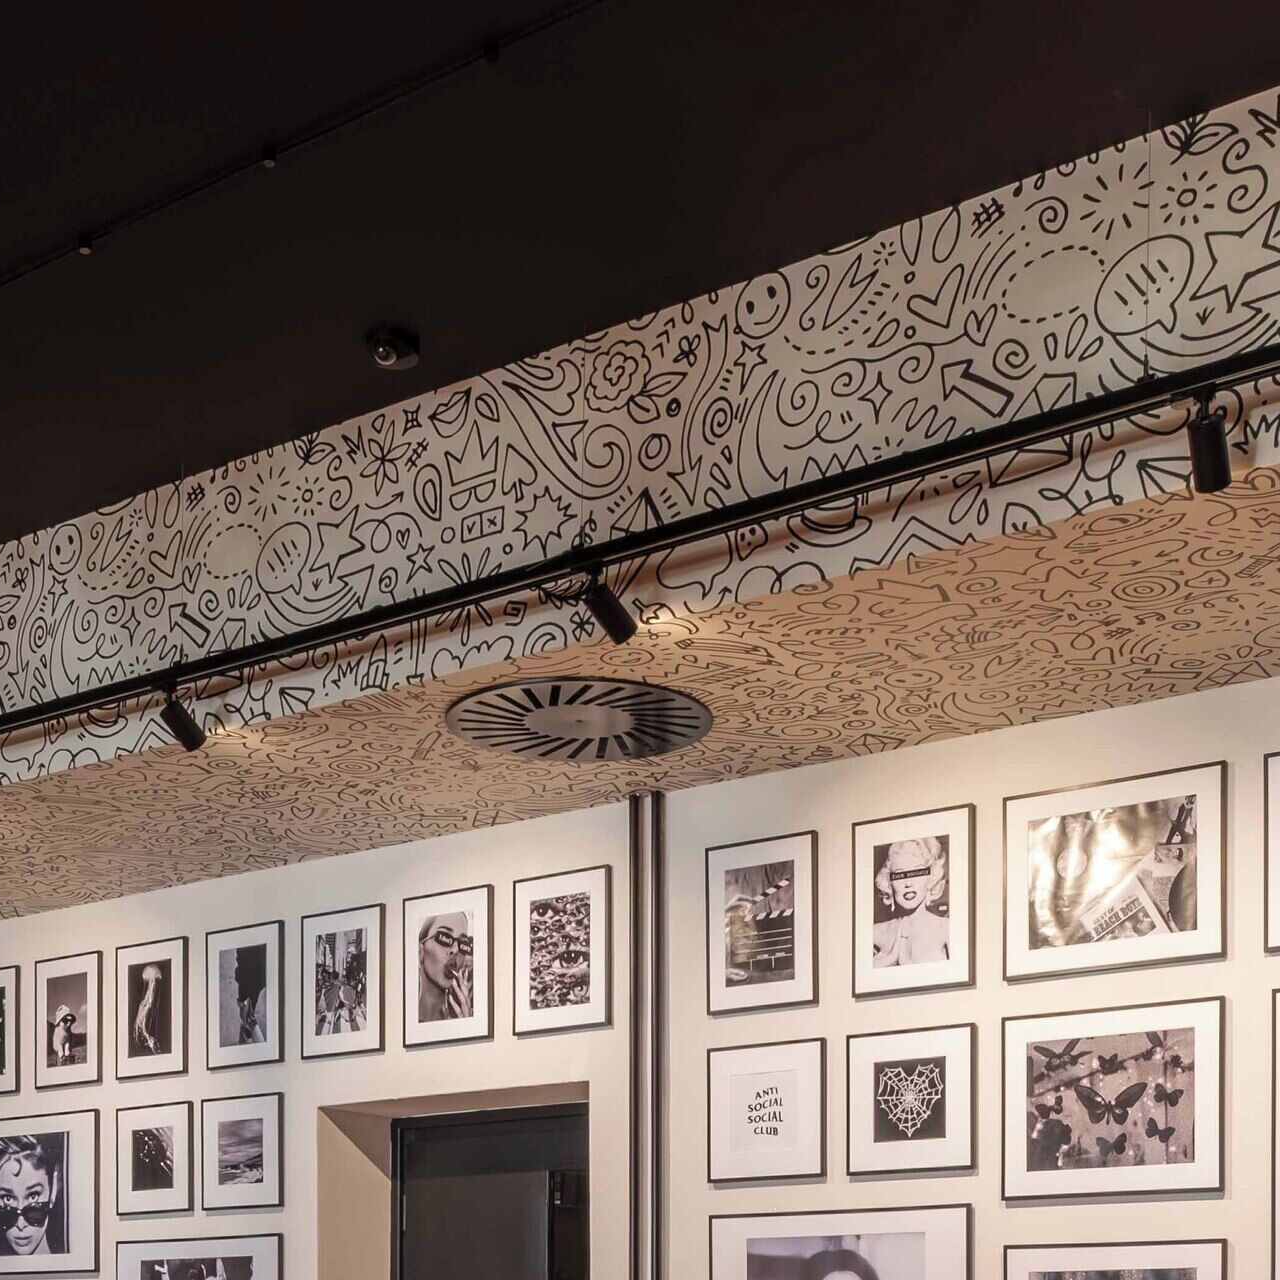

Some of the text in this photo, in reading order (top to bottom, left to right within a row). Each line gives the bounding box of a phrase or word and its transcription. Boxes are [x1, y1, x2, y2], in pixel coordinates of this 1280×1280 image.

[755, 1086, 779, 1100] ANTI
[747, 1097, 784, 1113] SOCIAL
[747, 1110, 784, 1124] SOCIAL
[753, 1126, 779, 1136] CLUB
